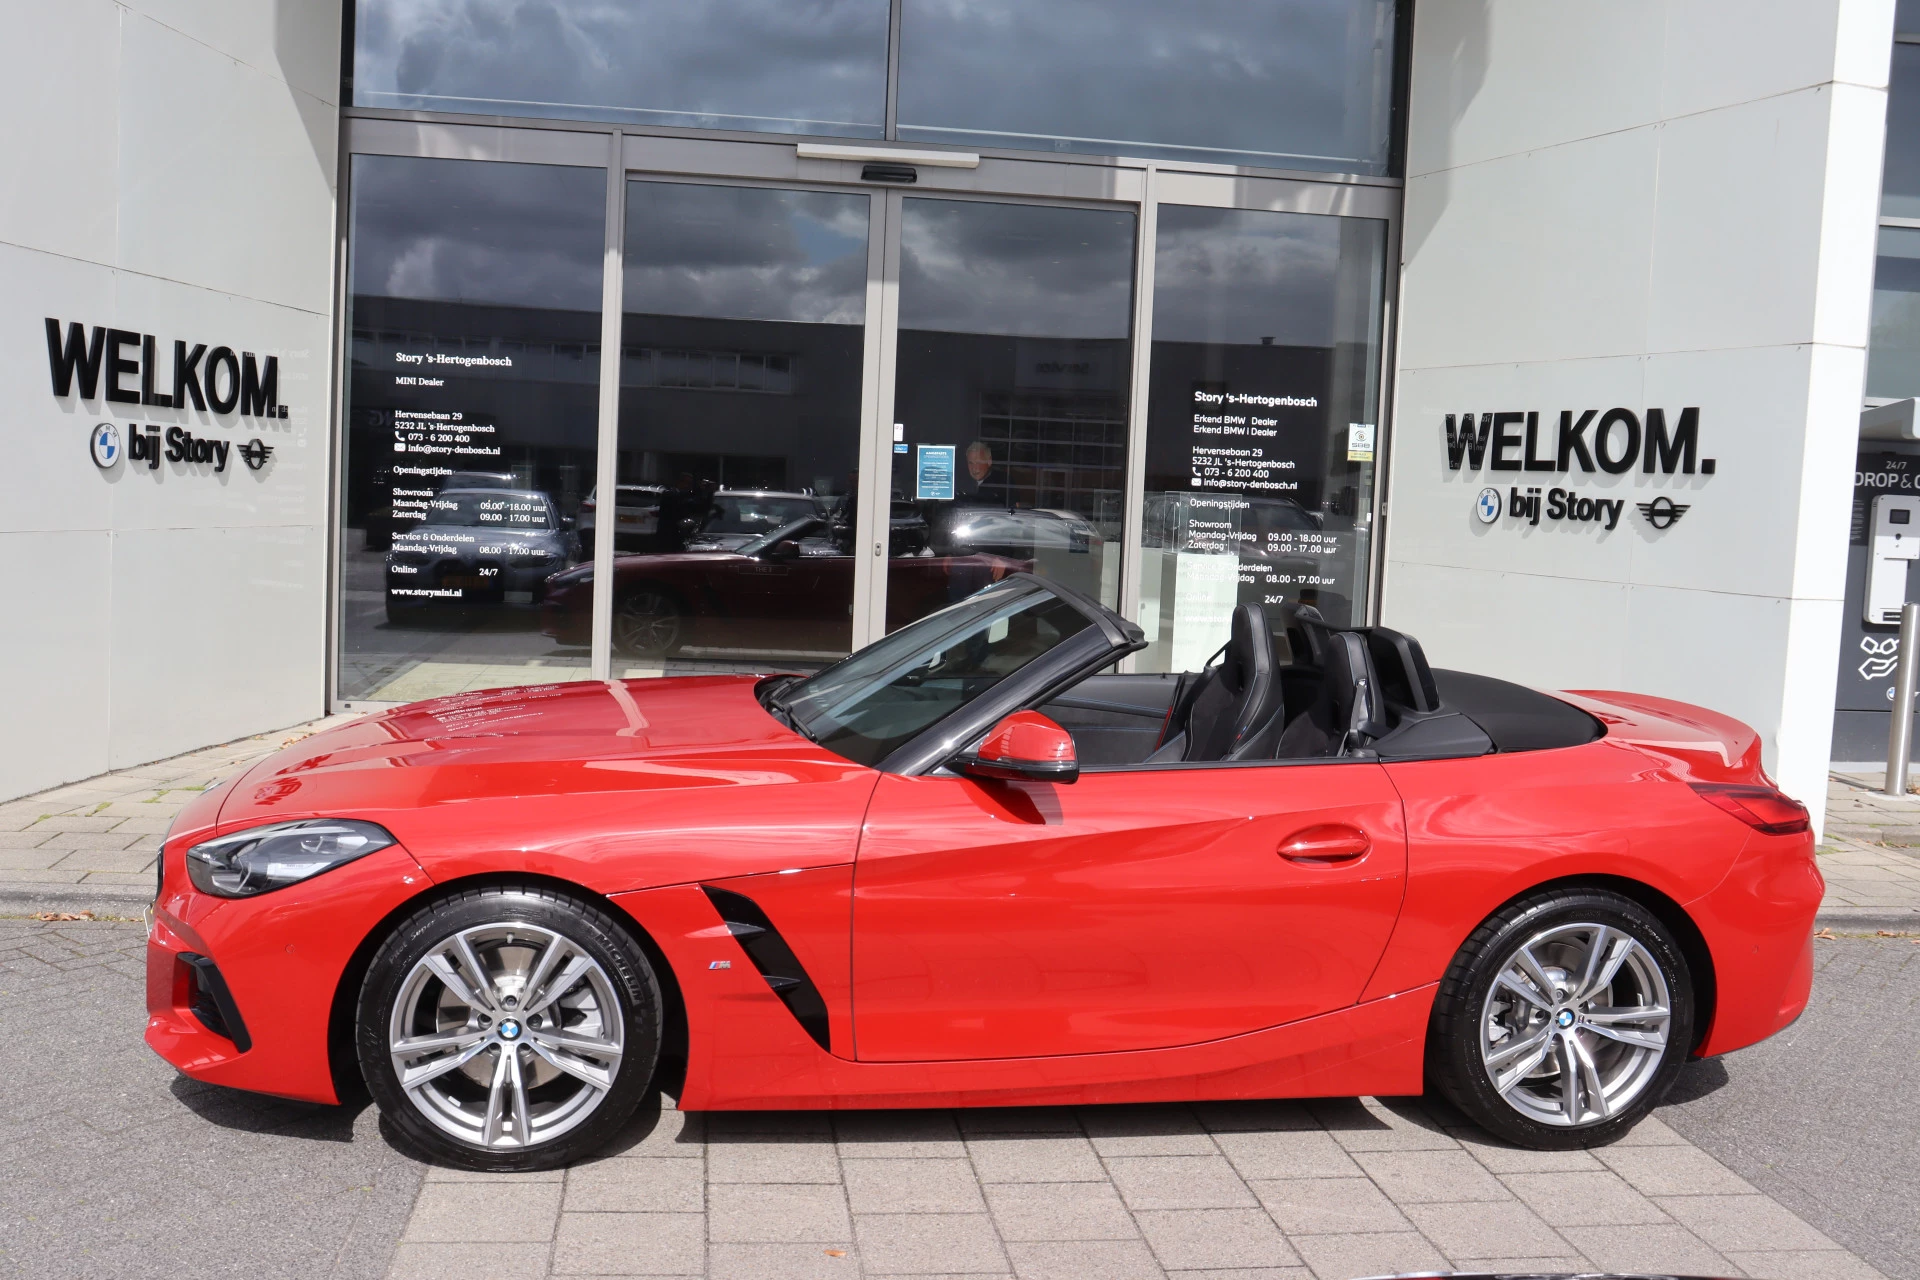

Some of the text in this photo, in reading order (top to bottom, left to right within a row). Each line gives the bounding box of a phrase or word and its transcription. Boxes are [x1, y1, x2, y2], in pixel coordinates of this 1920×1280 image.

[396, 352, 423, 365] Story
[45, 317, 289, 419] WELKOM.
[395, 376, 444, 386] MINI Dealer
[1194, 391, 1224, 404] Story
[395, 410, 450, 420] Hervensebaan
[452, 412, 462, 420] 29
[1194, 414, 1277, 426] Erkend BMW Dealer
[395, 422, 415, 430] 5232
[416, 422, 426, 430] JL
[1194, 425, 1222, 434] Erkend
[1224, 426, 1245, 435] BMW
[1251, 428, 1277, 437] Dealer
[408, 433, 423, 441] 073
[430, 434, 436, 442] 6
[438, 434, 452, 442] 200
[454, 434, 470, 443] 400
[1445, 407, 1716, 475] WELKOM.
[128, 423, 230, 472] bij Story
[408, 443, 500, 455] info@story-denbosch.nl
[1193, 446, 1263, 457] Hervensebaan 29
[1192, 457, 1212, 466] 5232
[1214, 458, 1222, 466] JL
[1886, 460, 1907, 469] 24/7
[393, 466, 452, 476] Openingstijden
[1204, 468, 1220, 476] 073
[1227, 469, 1233, 477] 6
[1235, 469, 1250, 477] 200
[1252, 470, 1269, 478] 400
[1204, 478, 1298, 490] info@story-denbosch.nl
[1855, 472, 1899, 488] DROP
[1900, 474, 1912, 488] &
[393, 488, 434, 497] Showroom
[393, 499, 458, 510] Maandag-Vrijdag
[480, 502, 502, 510] 09.00
[510, 503, 531, 512] 18.00
[1190, 498, 1250, 509] Openingstijden
[1509, 487, 1625, 530] bij Story
[392, 510, 426, 520] Zaterdag
[509, 514, 530, 522] 17.00
[1189, 520, 1232, 529] Showroom
[392, 532, 474, 542] Service & Onderdelen
[1188, 530, 1257, 542] Maandag-Vrijdag
[1268, 533, 1292, 541] 09.00
[1300, 534, 1322, 543] 18.00
[1323, 536, 1337, 544] uur
[392, 544, 457, 554] Maandag-Vrijdag
[480, 546, 502, 554] 08.00
[1188, 540, 1224, 551] Zaterdag
[1267, 544, 1292, 553] 09.00
[1299, 544, 1321, 553] 17.00
[1323, 546, 1337, 554] uur
[392, 565, 498, 576] Online 24/7
[1266, 575, 1290, 584] 08.00
[1298, 576, 1320, 585] 17.00
[391, 588, 462, 597] www.storymini.nl
[1264, 595, 1283, 604] 24/7
